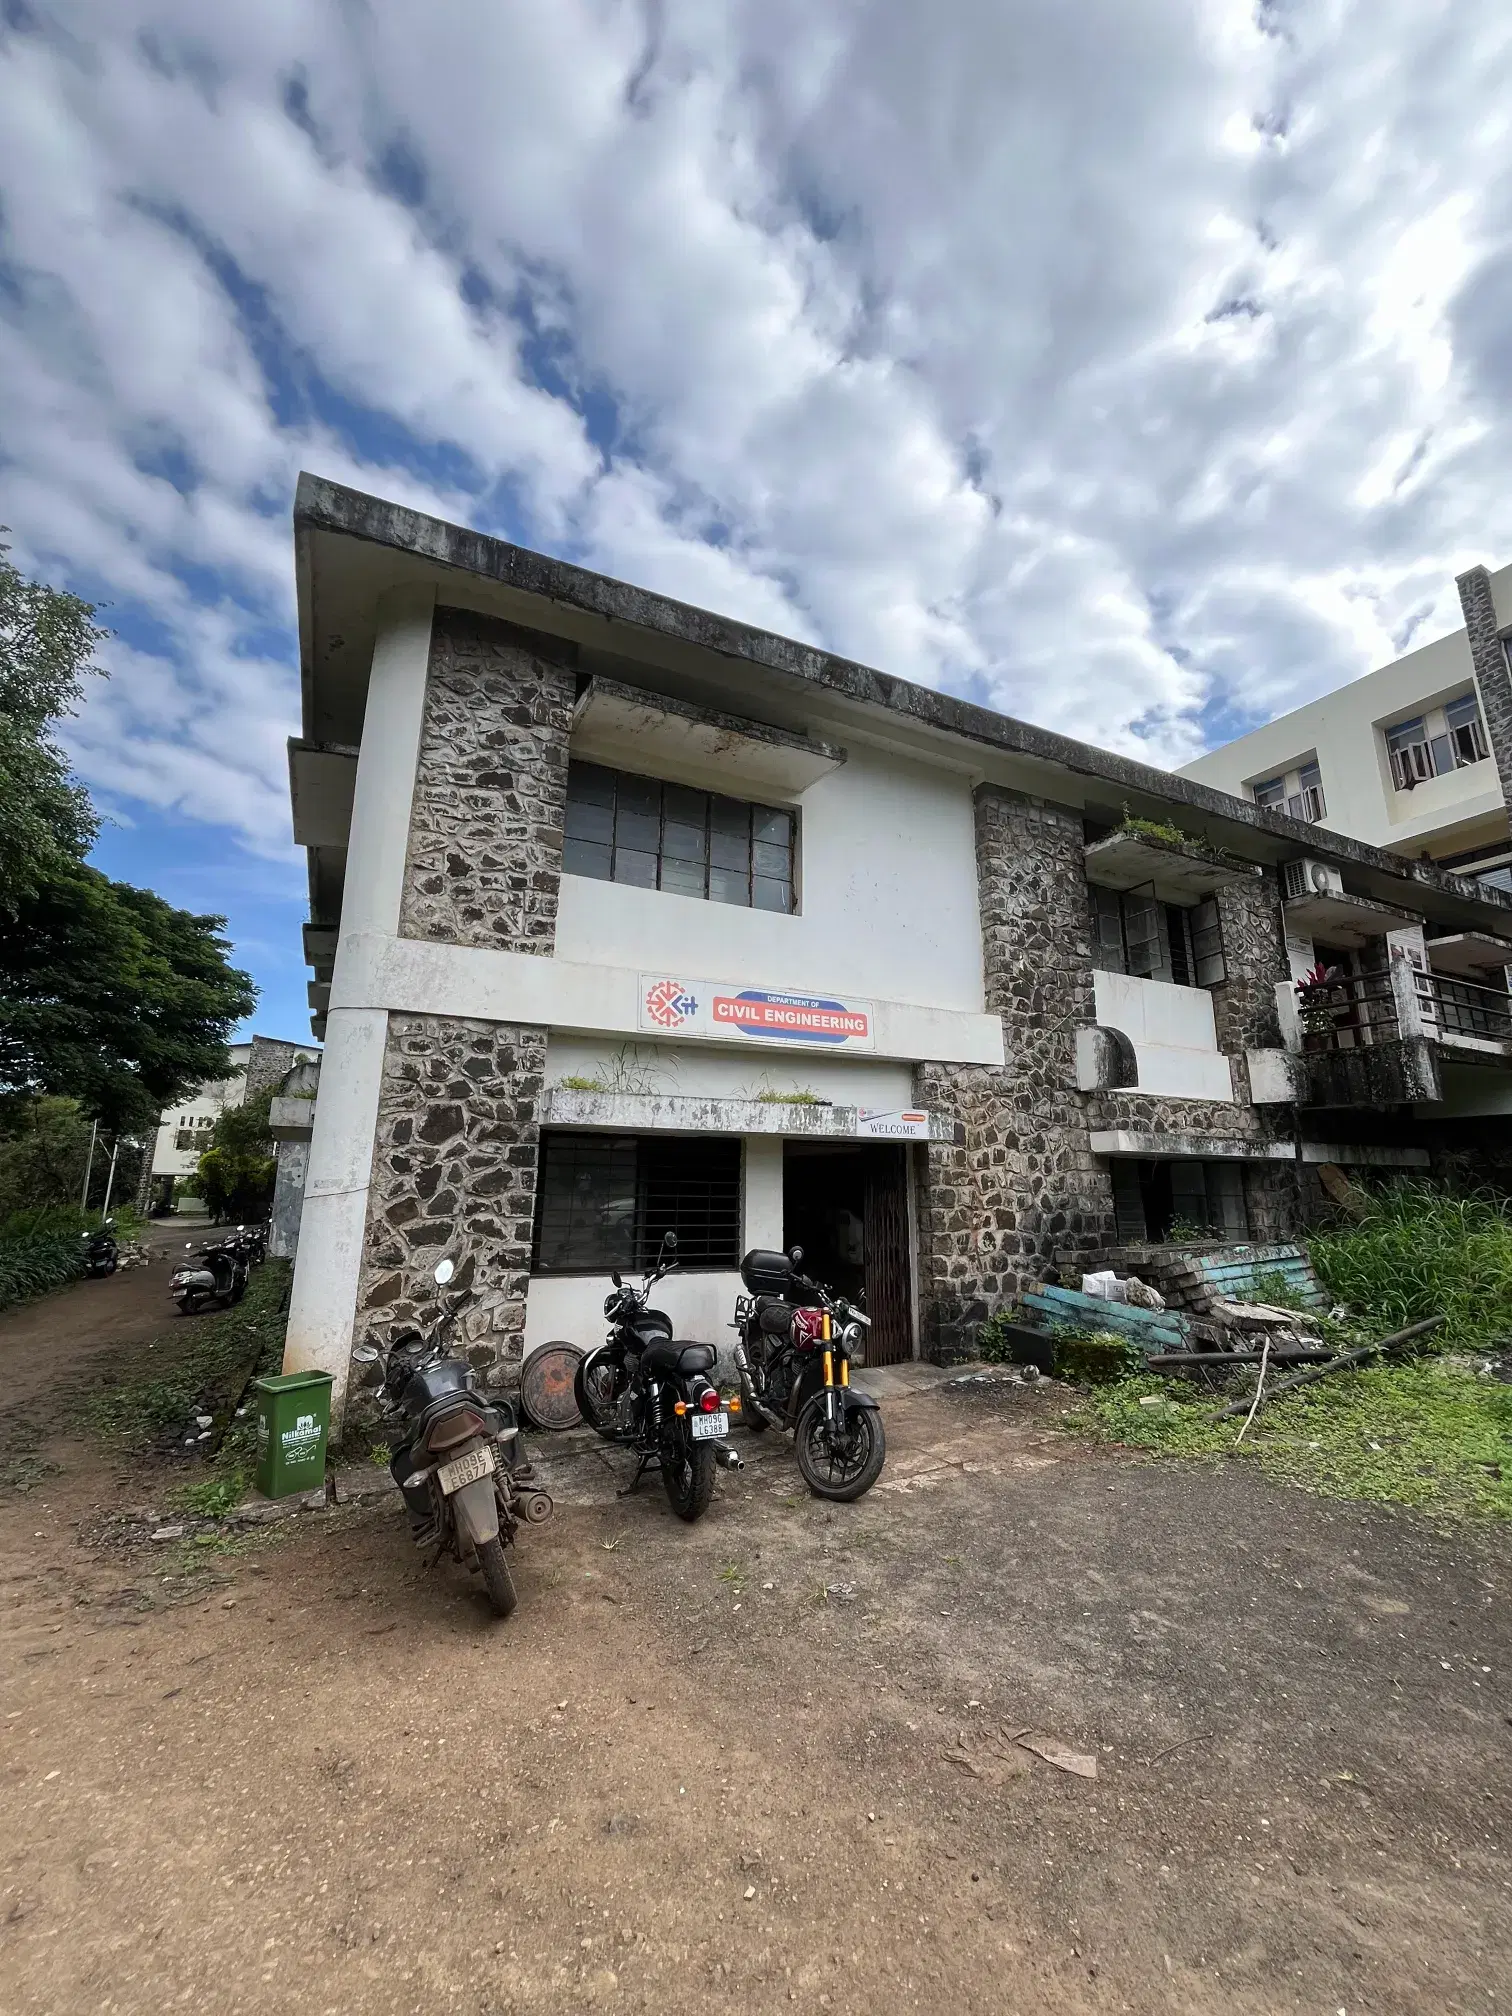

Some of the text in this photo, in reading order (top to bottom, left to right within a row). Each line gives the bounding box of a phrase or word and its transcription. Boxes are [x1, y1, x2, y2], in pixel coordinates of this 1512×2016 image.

[767, 995, 809, 1007] DEPARTMENT
[717, 1003, 865, 1031] CIVIL ENGINEERING
[870, 1122, 916, 1135] WELCOME
[282, 1425, 321, 1440] Nilkamal
[448, 1451, 485, 1477] MH09E
[451, 1462, 487, 1490] E6877
